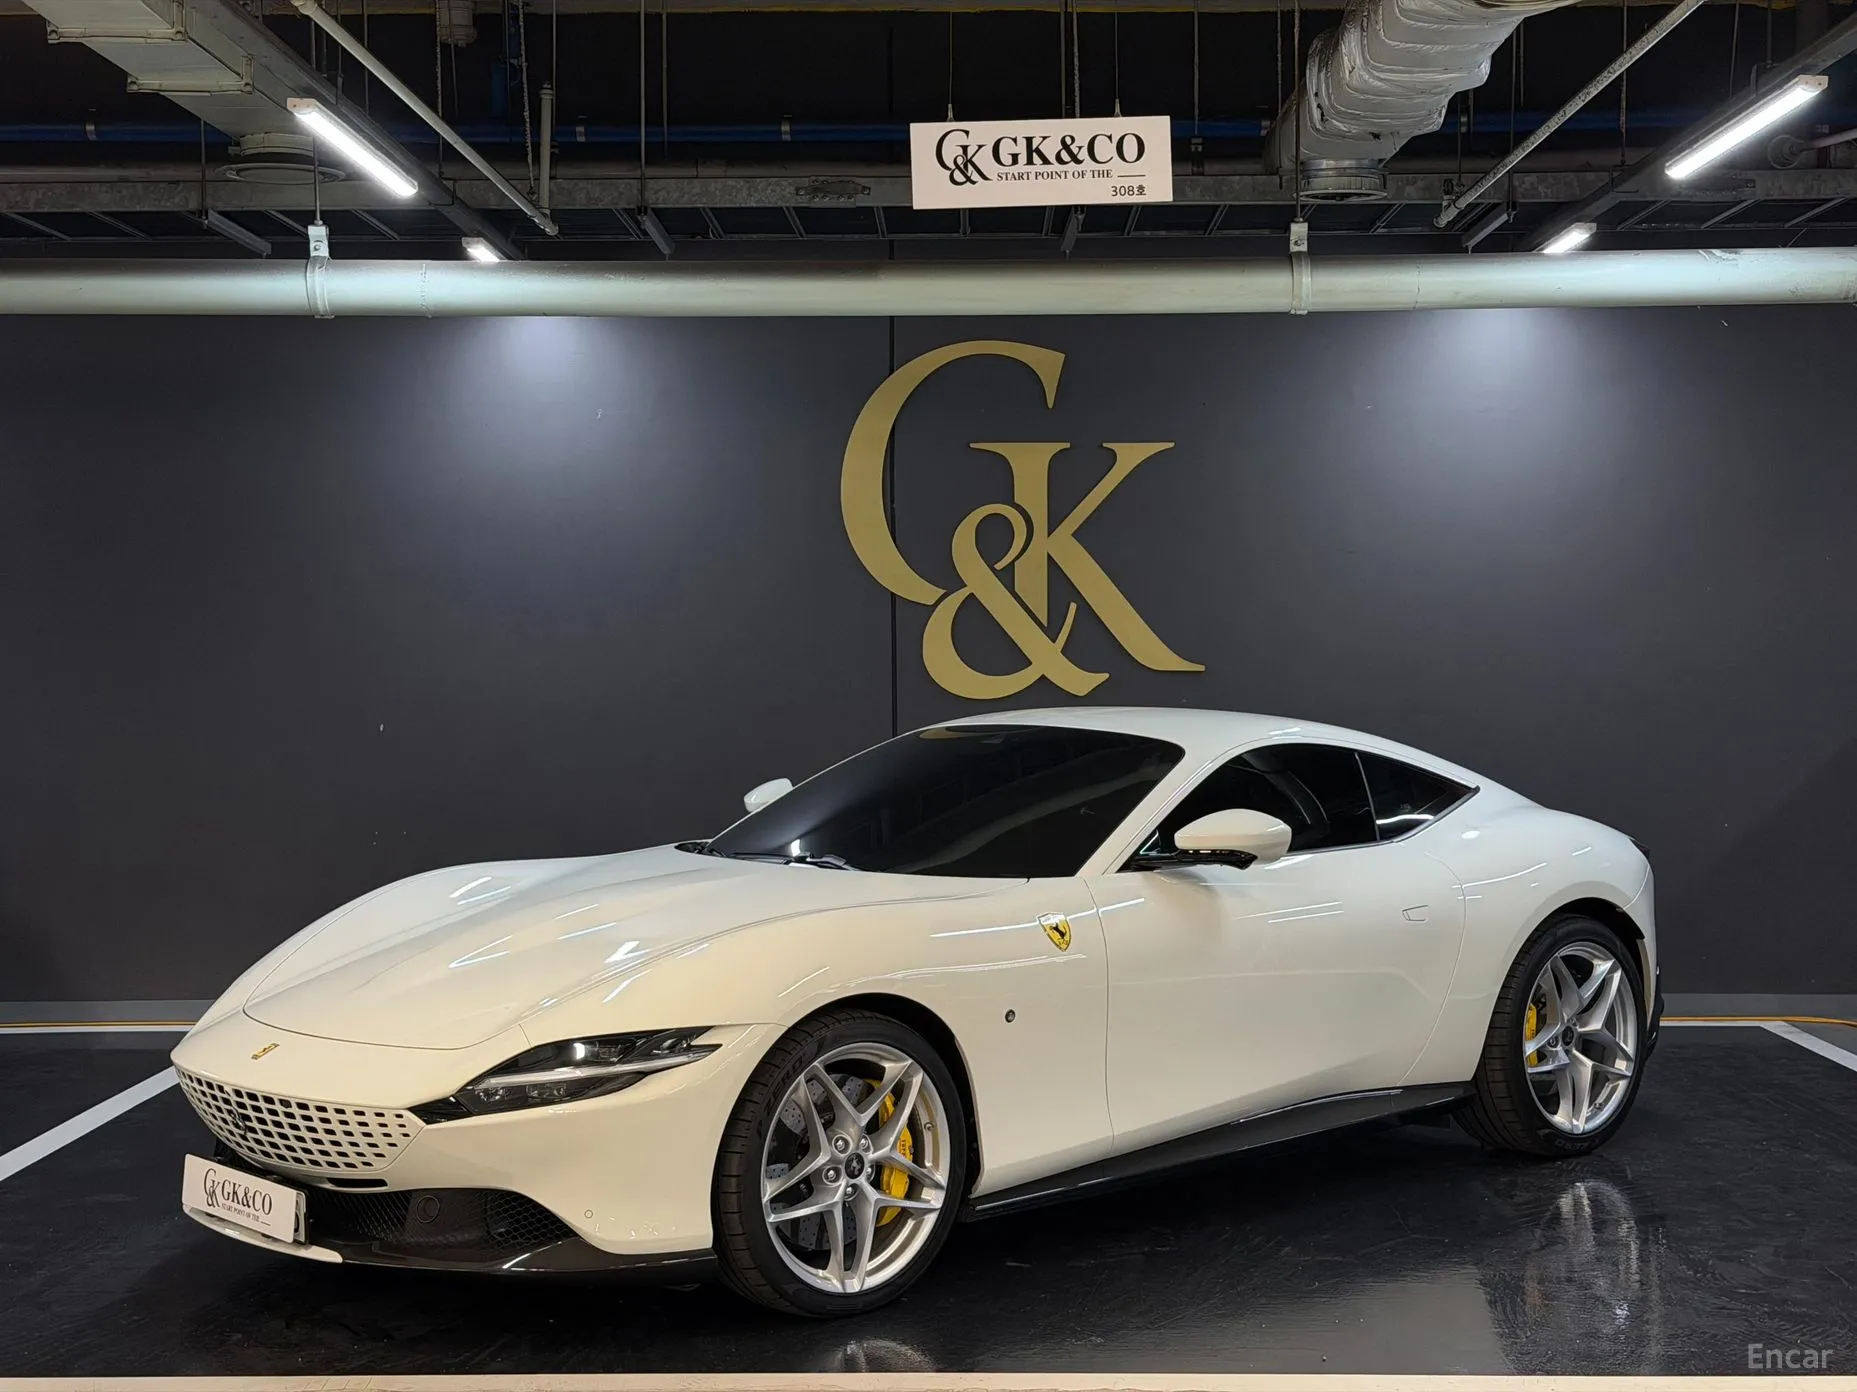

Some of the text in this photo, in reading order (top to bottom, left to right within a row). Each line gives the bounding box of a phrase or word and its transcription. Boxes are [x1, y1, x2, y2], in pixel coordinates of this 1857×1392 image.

[991, 132, 1146, 167] GK&CO
[996, 169, 1113, 182] START POINT OF THE
[1110, 184, 1147, 198] 308호
[221, 1179, 273, 1216] GK&CO
